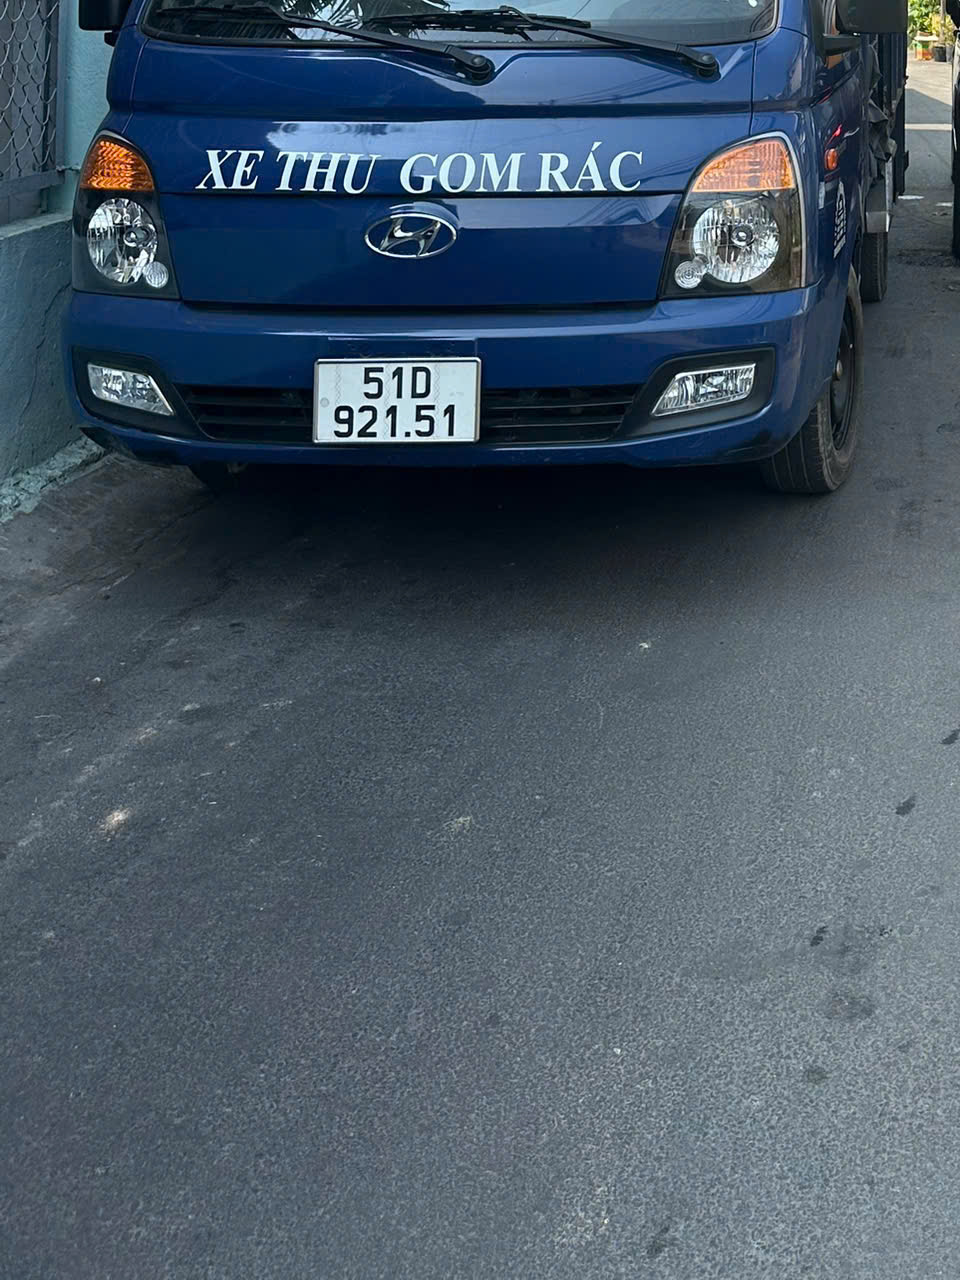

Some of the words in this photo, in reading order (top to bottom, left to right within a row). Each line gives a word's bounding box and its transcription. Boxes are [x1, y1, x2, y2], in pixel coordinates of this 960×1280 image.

[195, 149, 265, 191] XE
[275, 151, 381, 195] THU
[399, 151, 526, 195] GOM
[535, 141, 644, 193] RÁC
[363, 366, 432, 400] 51D
[333, 404, 456, 439] 921.51
